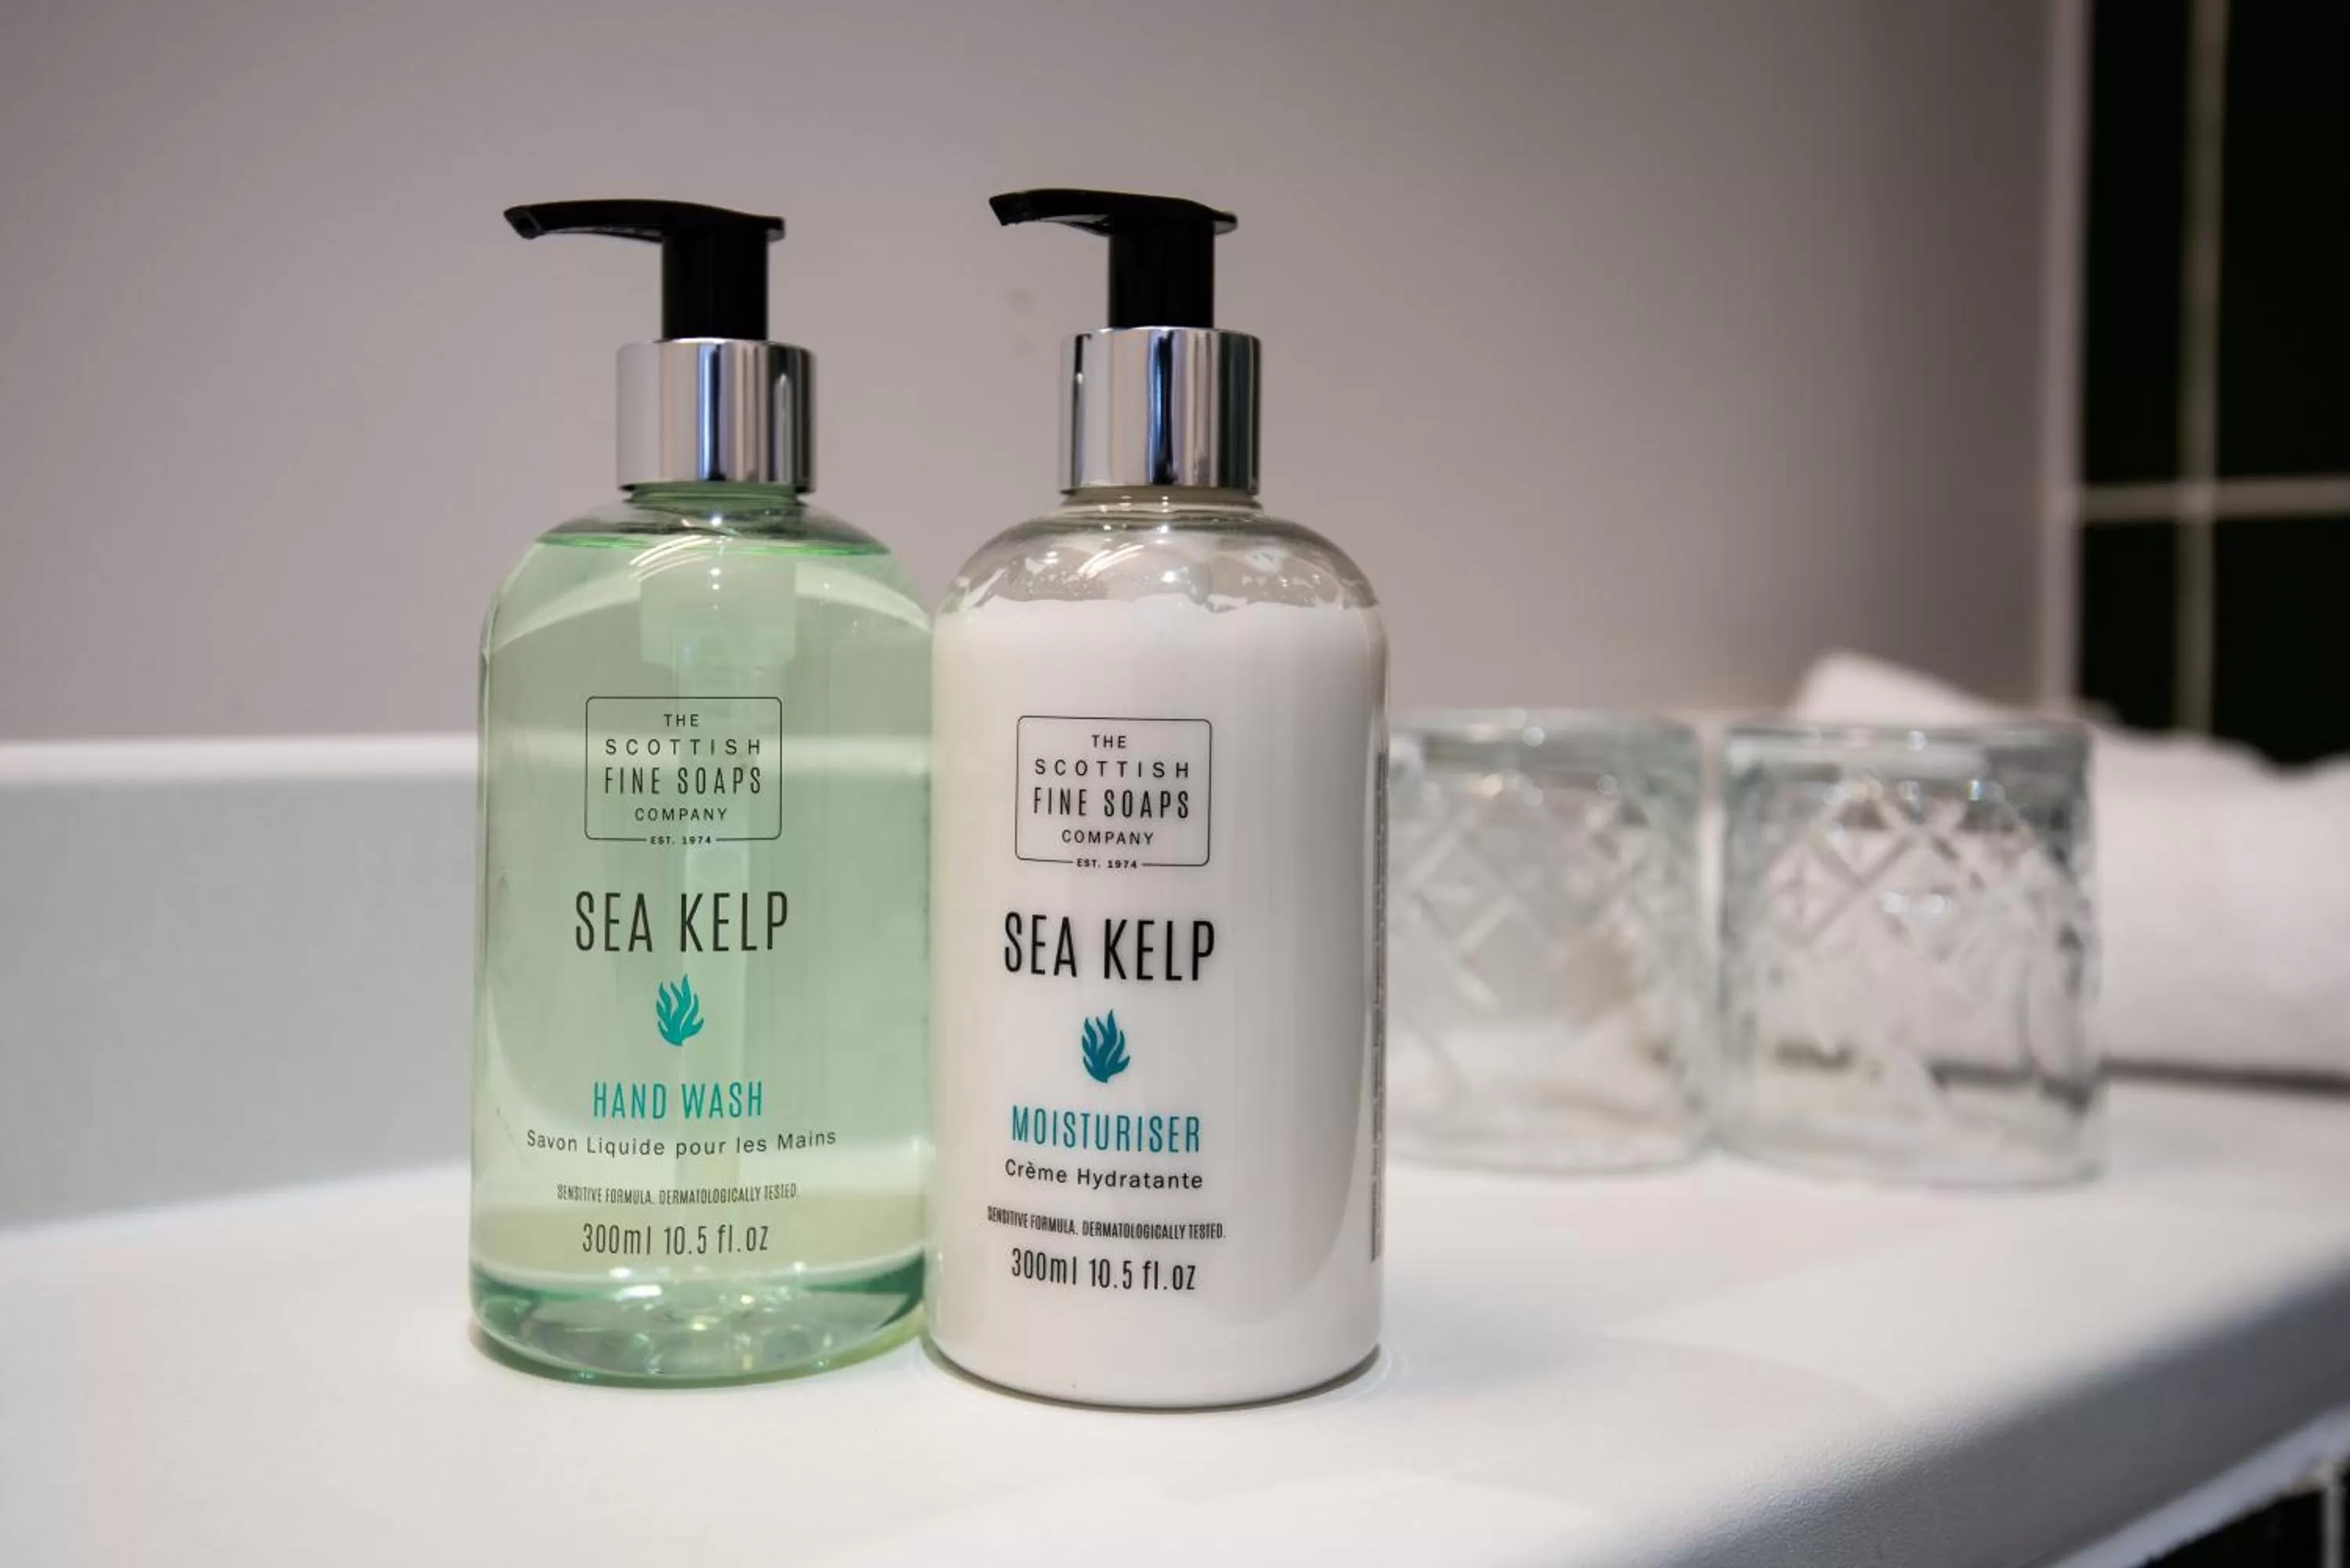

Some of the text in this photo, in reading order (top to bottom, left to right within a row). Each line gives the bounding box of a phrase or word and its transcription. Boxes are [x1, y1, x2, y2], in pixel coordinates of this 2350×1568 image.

[664, 714, 700, 727] THE
[606, 739, 761, 755] SCOTTISH
[1091, 734, 1127, 749] THE
[605, 767, 761, 794] FINE SOAPS
[1034, 759, 1190, 779] SCOTTISH
[635, 807, 728, 822] COMPANY
[1033, 786, 1189, 818] FINE SOAPS
[651, 836, 712, 845] EST. 1974
[1061, 829, 1154, 845] COMPANY
[1077, 858, 1137, 869] EST. 1974
[576, 891, 788, 952] SEA KELP
[1004, 911, 1215, 981] SEA KELP
[593, 1081, 763, 1119] HAND WASH
[1011, 1105, 1201, 1154] MOISTURISER
[526, 1129, 837, 1159] Savon Liquide pour les Mains
[1004, 1158, 1203, 1190] Crème Hydratante
[557, 1183, 602, 1203] SENSITIVE
[606, 1187, 656, 1205] FORMULA.
[659, 1187, 761, 1205] DERMATOLOGICALLY
[987, 1205, 1227, 1240] SENSITIVE FORMULA. DERMATOLOGICALLY TESTED.
[582, 1223, 769, 1255] 300ml 10.5 fl.oz
[1011, 1247, 1197, 1291] 300ml 10.5 fl.oz
